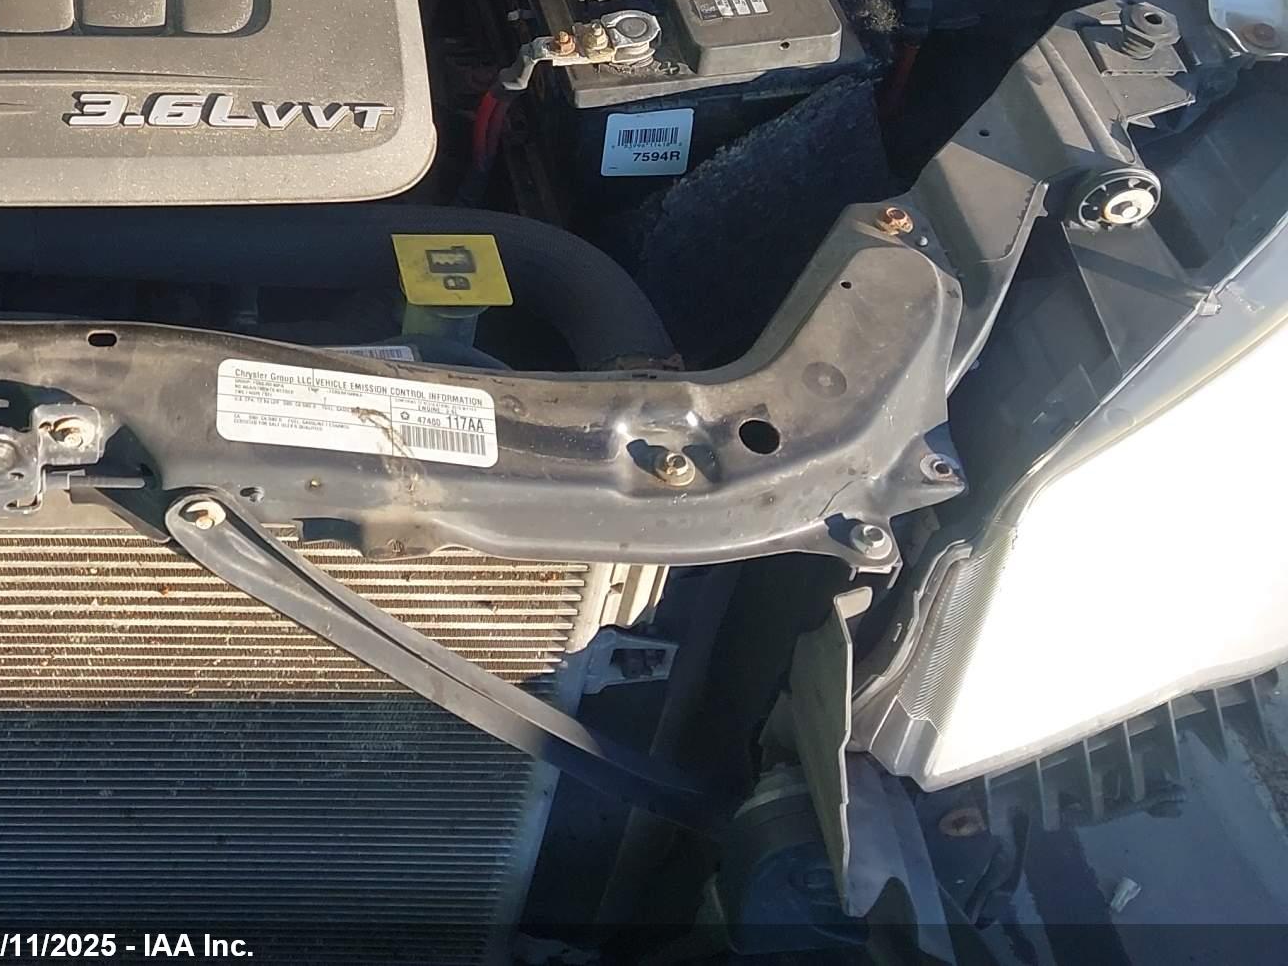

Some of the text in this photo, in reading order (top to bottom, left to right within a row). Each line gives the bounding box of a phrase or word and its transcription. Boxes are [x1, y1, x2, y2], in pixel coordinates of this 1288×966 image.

[65, 91, 396, 132] 3.6L VVT
[633, 150, 680, 162] 7594R
[234, 368, 267, 380] Chrysler
[270, 372, 294, 384] Group
[297, 376, 312, 384] LLC
[316, 378, 347, 389] VEHICLE
[350, 381, 388, 394] EMISSION
[390, 387, 425, 399] CONTROL
[429, 392, 482, 406] INFORMATION
[448, 416, 484, 432] 117AA
